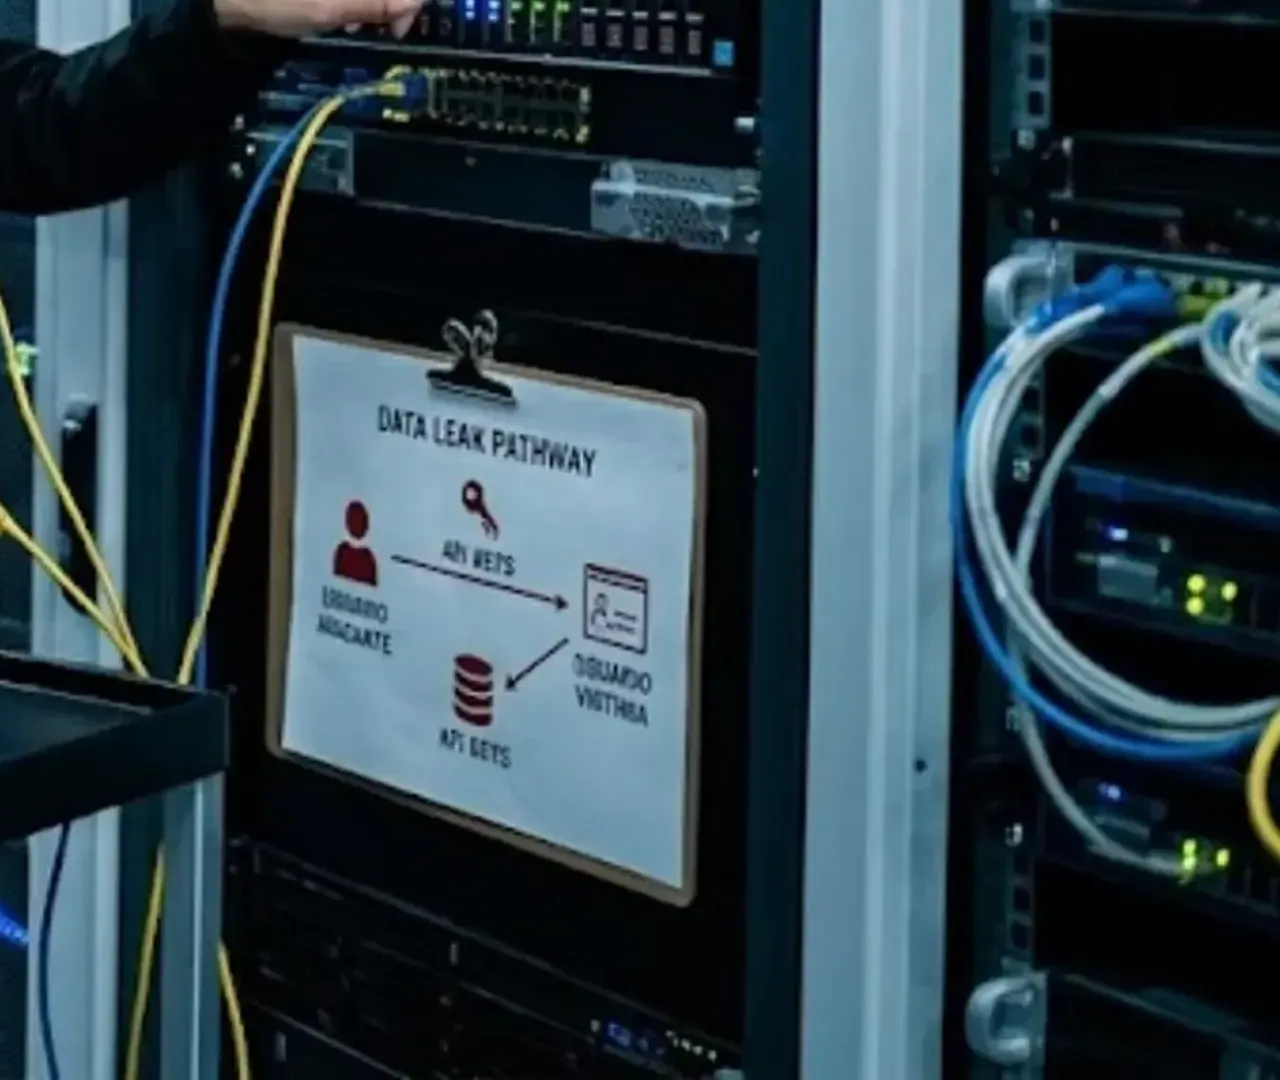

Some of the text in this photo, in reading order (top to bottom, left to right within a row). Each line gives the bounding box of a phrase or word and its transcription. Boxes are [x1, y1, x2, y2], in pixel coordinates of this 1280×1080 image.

[378, 405, 596, 477] DATA LEAK PATHWAY
